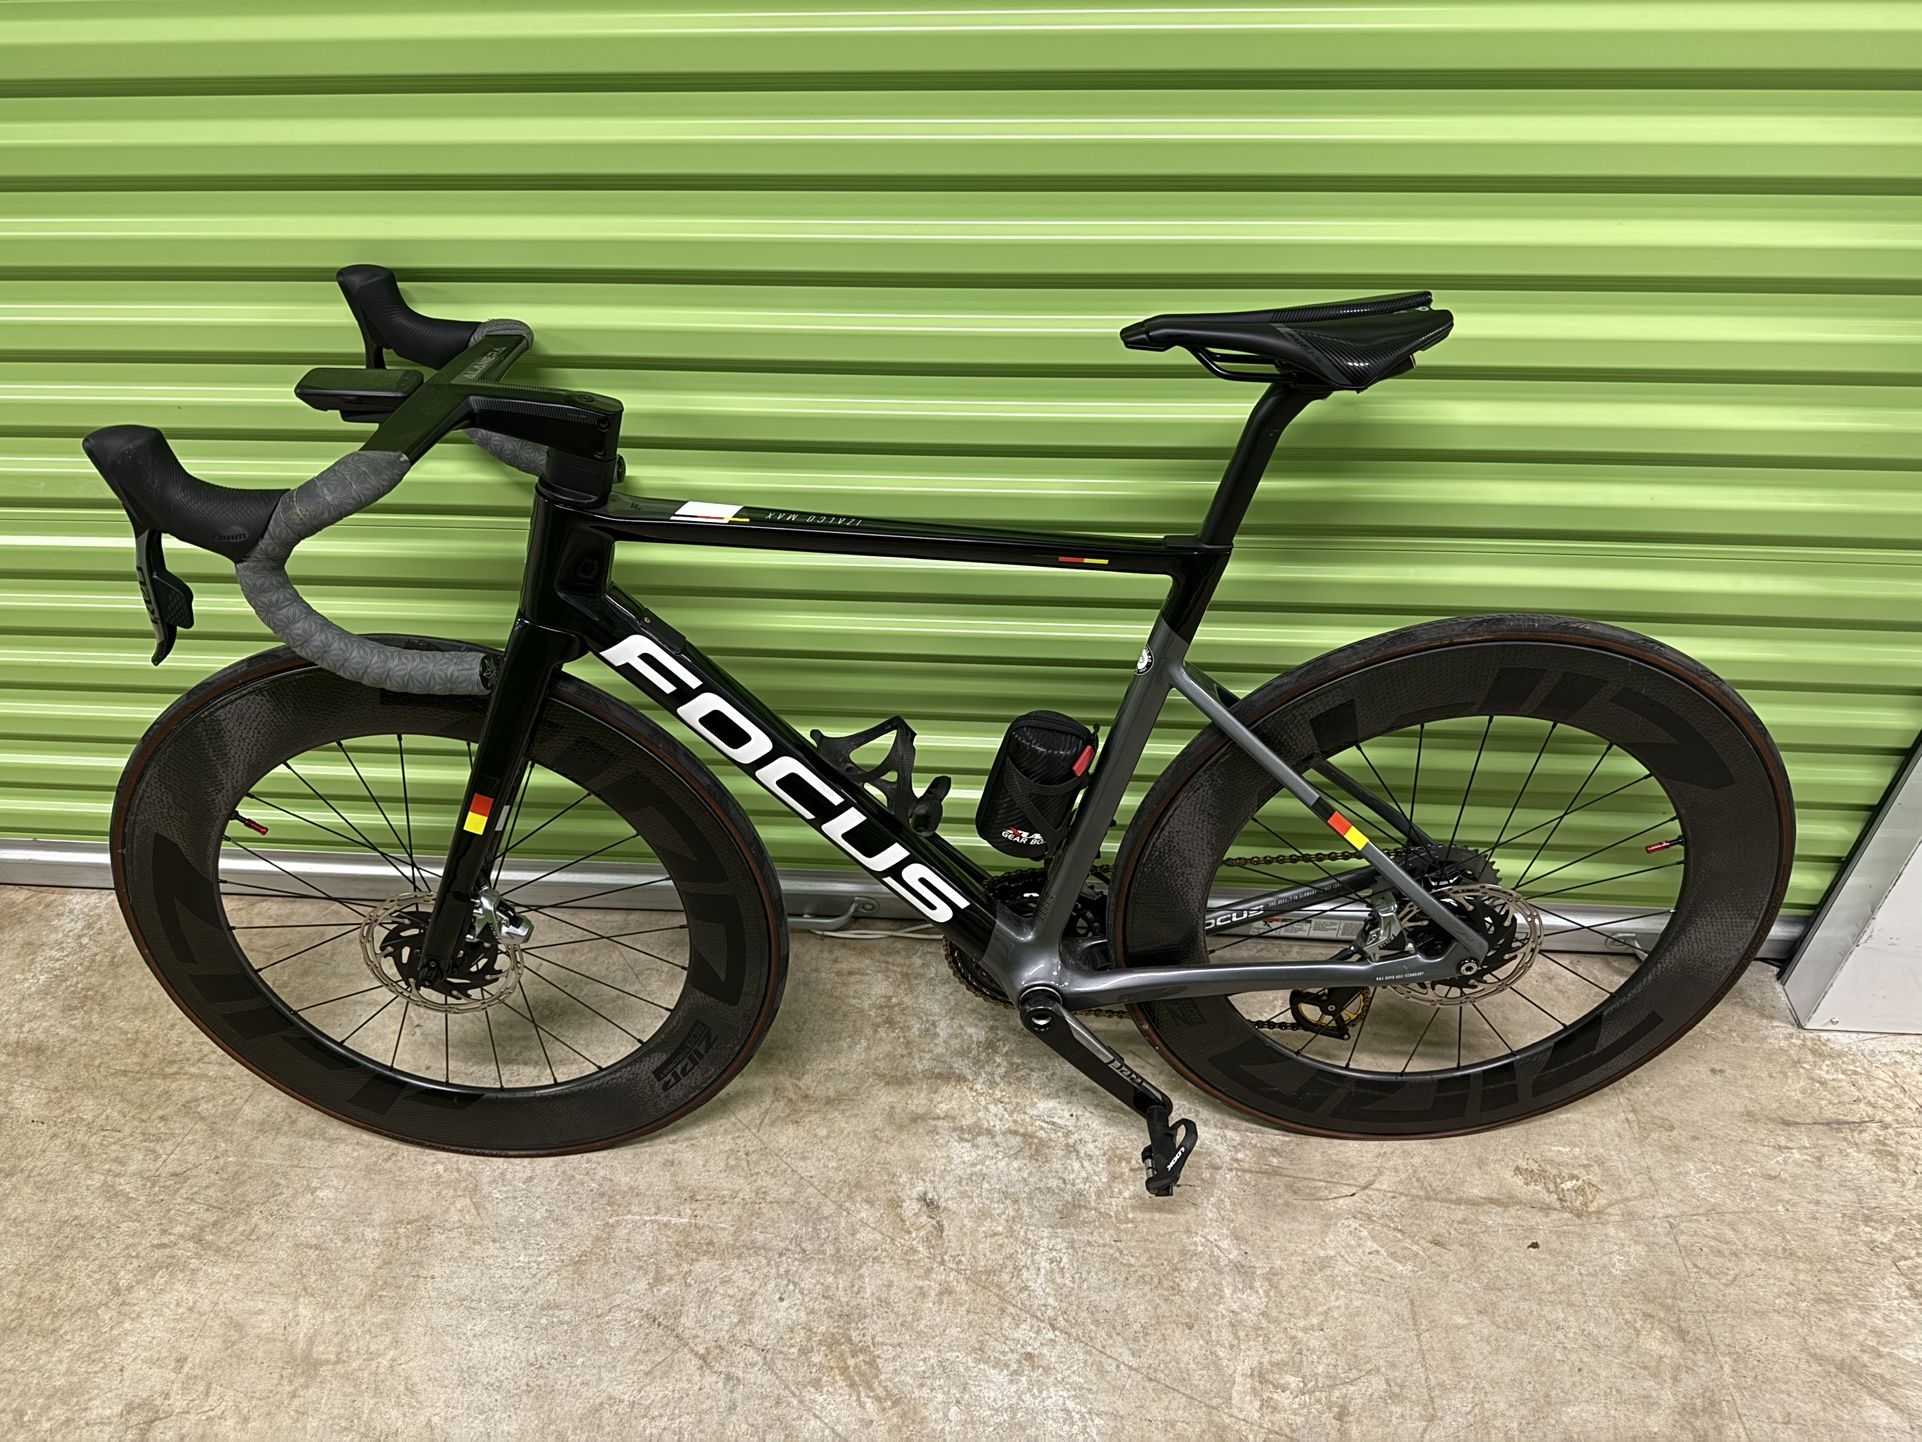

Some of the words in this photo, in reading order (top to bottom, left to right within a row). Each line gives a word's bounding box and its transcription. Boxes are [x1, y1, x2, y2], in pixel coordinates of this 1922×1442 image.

[764, 512, 799, 521] MAX
[806, 515, 862, 527] IZALCO
[600, 634, 971, 923] FOCUS
[1002, 831, 1028, 844] GEAR
[1205, 905, 1264, 930] OCUS
[1166, 1146, 1186, 1172] LOOK
